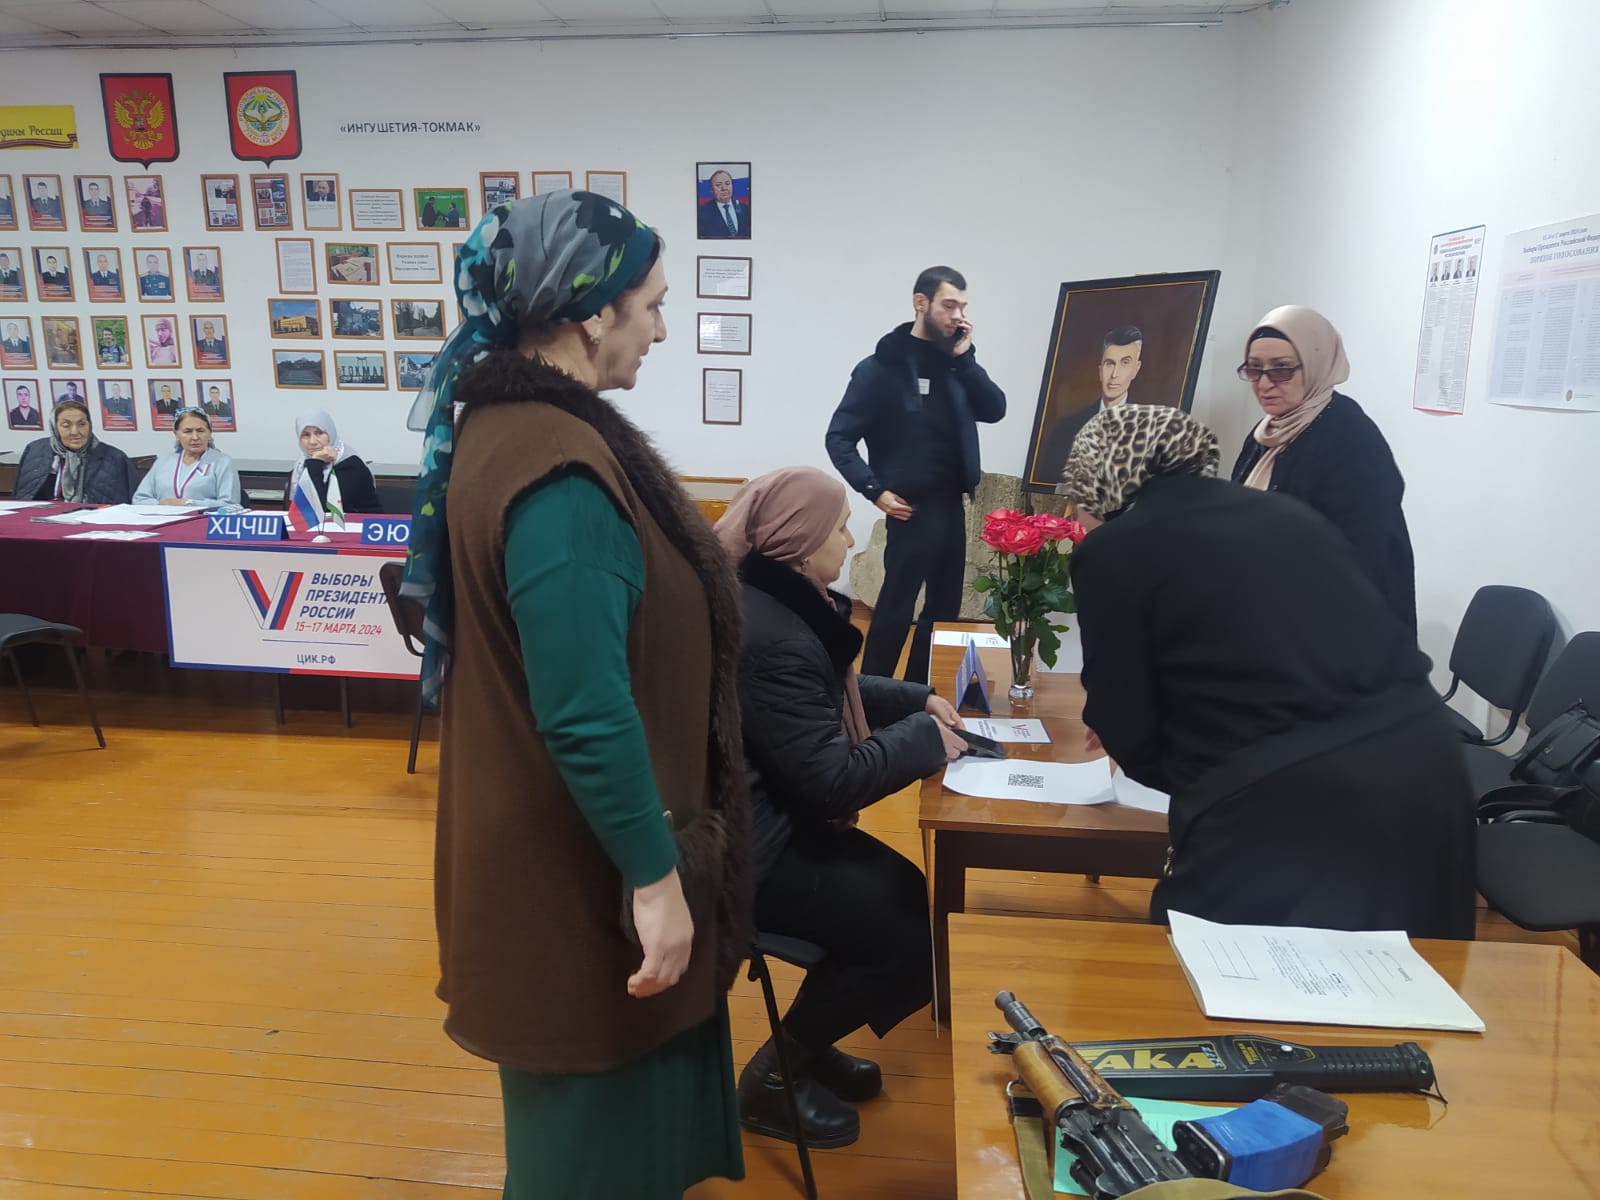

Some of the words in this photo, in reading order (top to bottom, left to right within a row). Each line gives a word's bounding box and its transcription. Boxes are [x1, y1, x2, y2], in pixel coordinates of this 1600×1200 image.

[340, 122, 481, 133] «ИНГУШЕТИЯ-ТОКМАК»
[208, 516, 278, 539] ХЦЧШ
[311, 573, 374, 588] ВЫБОРЫ
[299, 606, 355, 620] РОССИИ
[323, 622, 356, 634] МАРТА
[358, 624, 382, 635] 2024
[297, 654, 336, 665] ЦИК.РФ
